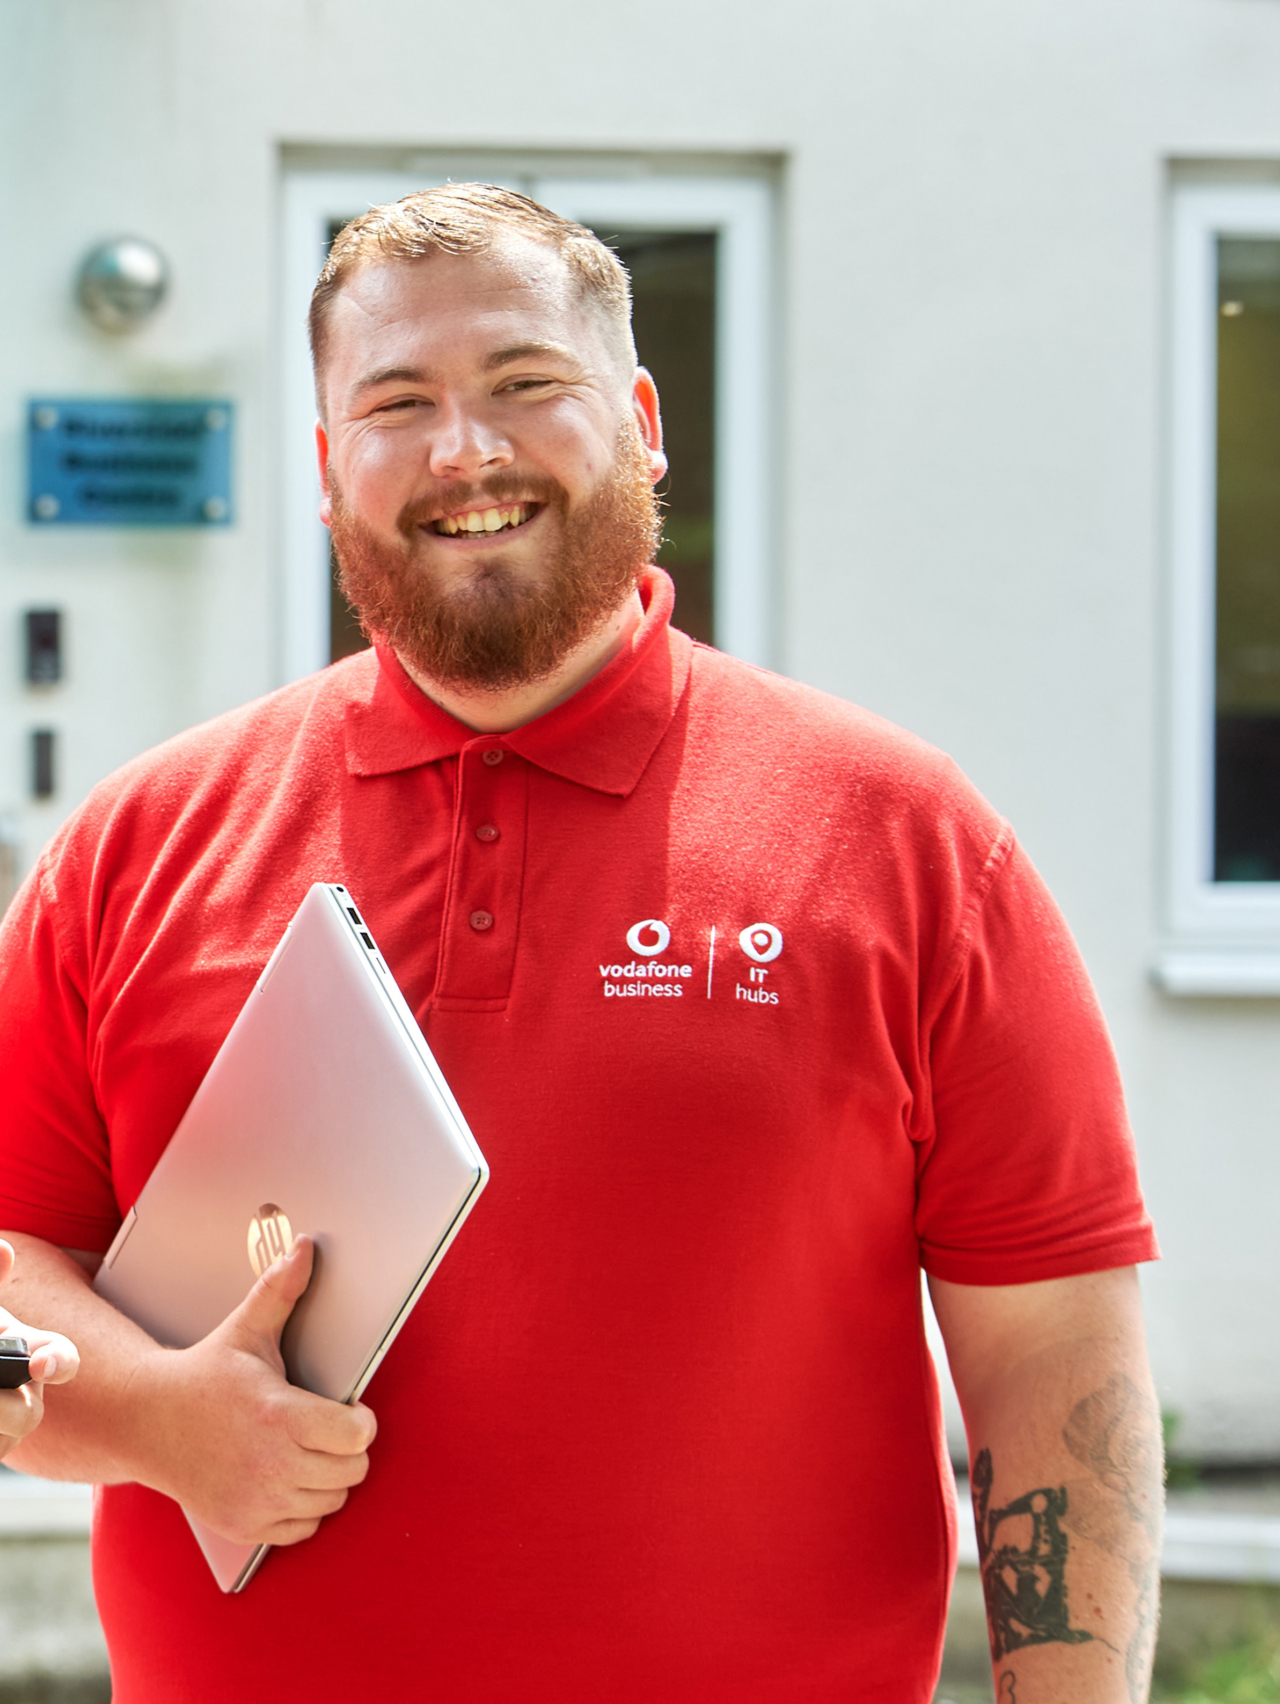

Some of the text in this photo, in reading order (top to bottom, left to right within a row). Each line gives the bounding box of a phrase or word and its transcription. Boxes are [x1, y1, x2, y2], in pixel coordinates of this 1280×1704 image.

[599, 960, 693, 978] vodafone
[749, 967, 769, 983] IT
[603, 980, 683, 997] business
[735, 983, 780, 1005] hubs
